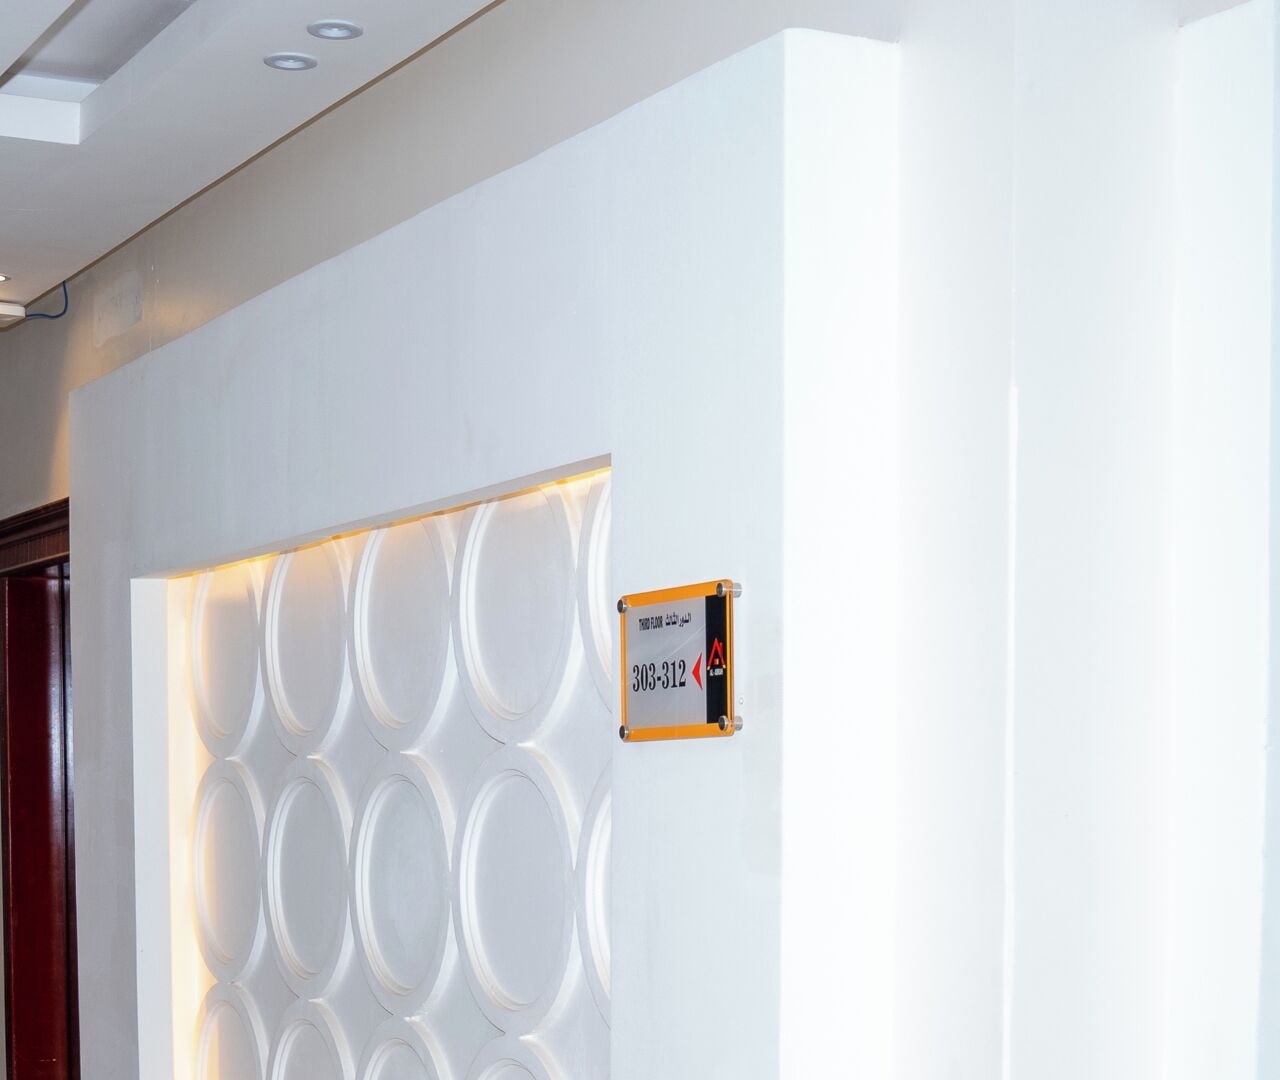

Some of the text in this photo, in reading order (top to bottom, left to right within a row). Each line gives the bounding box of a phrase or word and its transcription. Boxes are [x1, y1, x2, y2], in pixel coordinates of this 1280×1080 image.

[639, 616, 663, 631] THIRD FLOOR
[632, 659, 686, 692] 303-312
